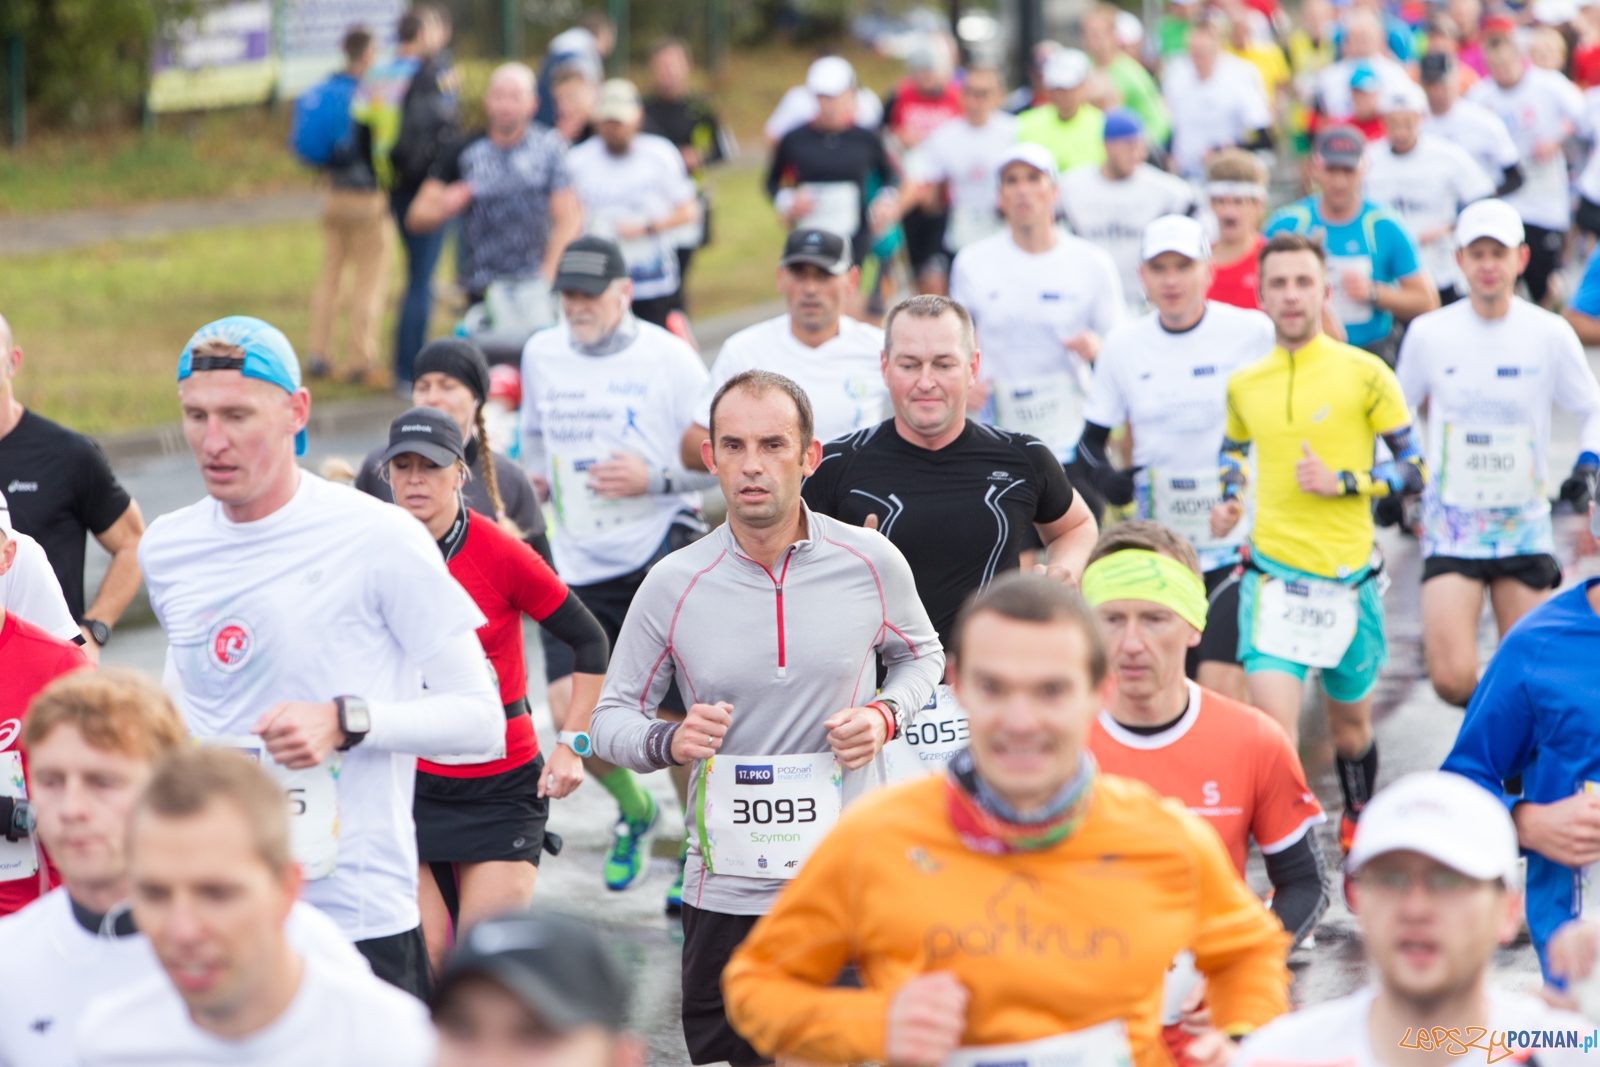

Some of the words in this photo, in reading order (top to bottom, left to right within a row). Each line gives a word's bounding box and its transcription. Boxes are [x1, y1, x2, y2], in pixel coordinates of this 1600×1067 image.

[401, 424, 433, 433] Reebok
[1467, 454, 1515, 472] 4130
[1283, 603, 1336, 630] 2390
[919, 749, 962, 762] Grzegor
[738, 769, 771, 780] 17.PKO
[1202, 780, 1221, 806] S
[733, 797, 817, 824] 3093
[750, 831, 801, 844] Szymon
[923, 903, 1131, 973] parkrun
